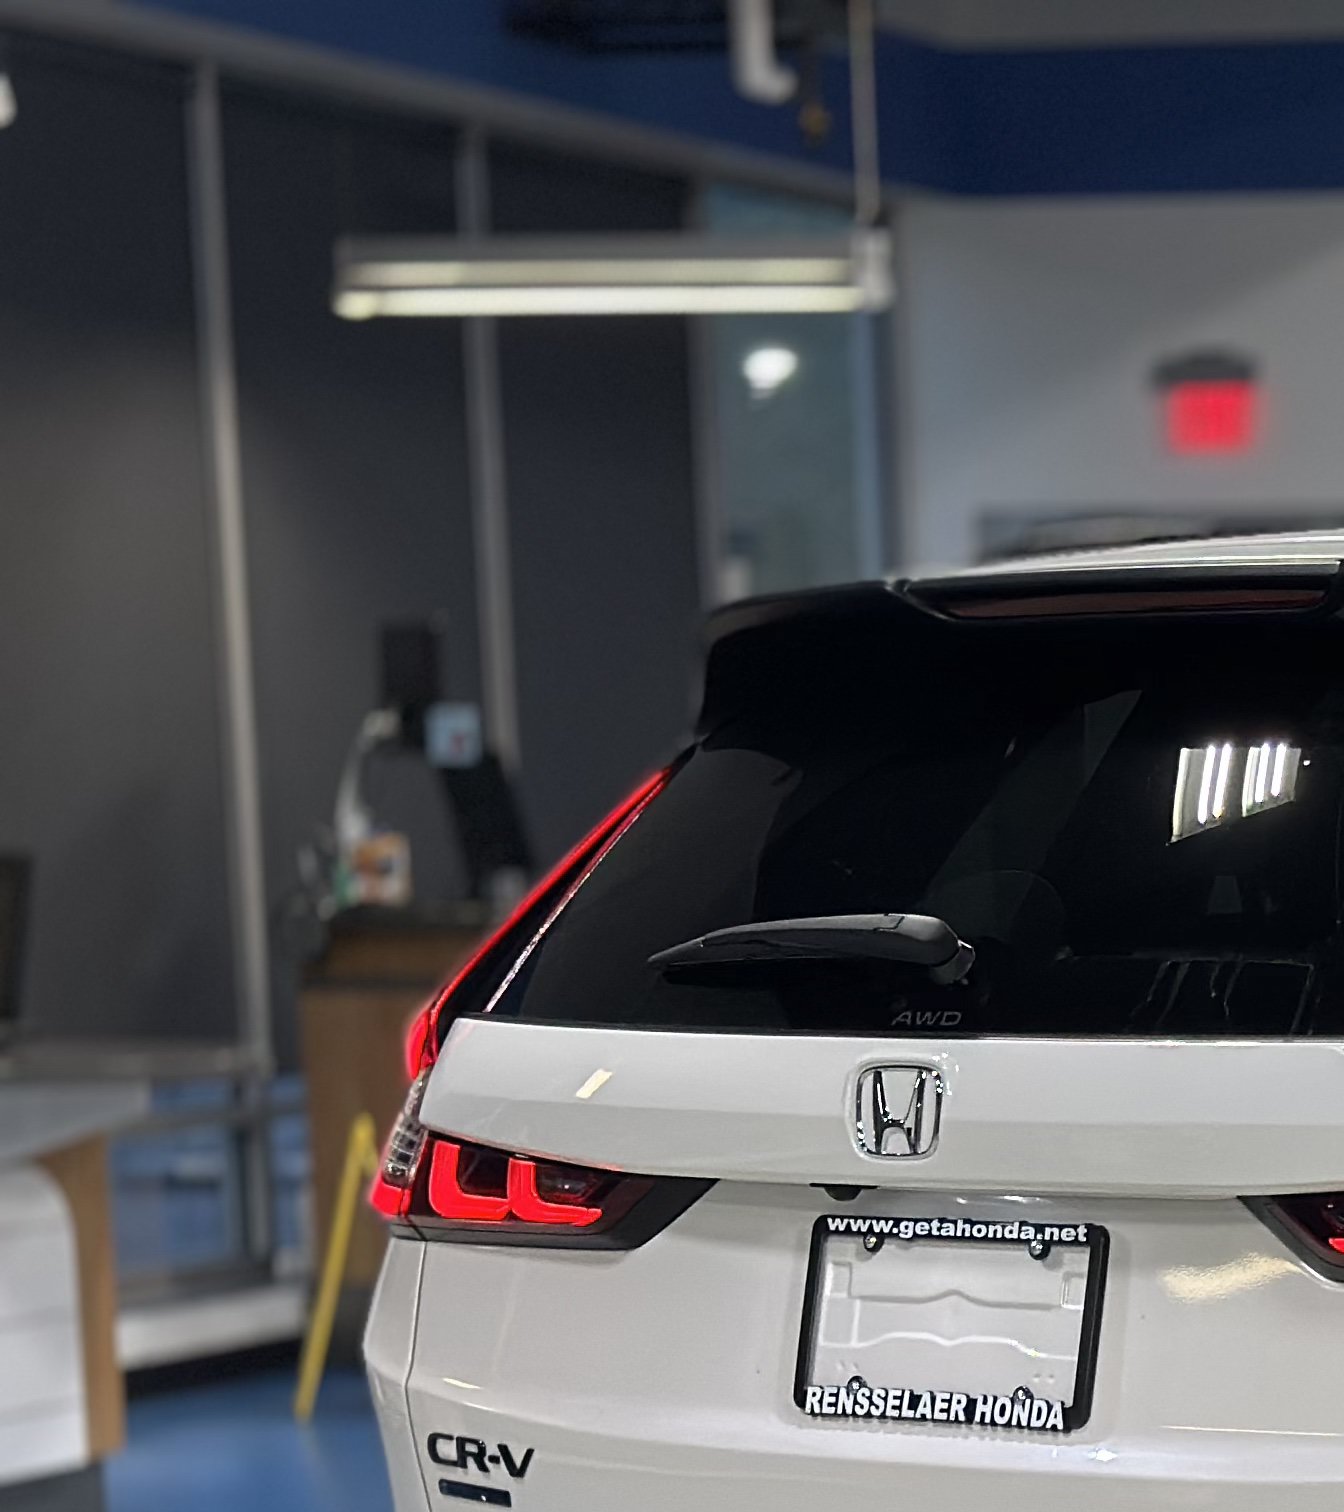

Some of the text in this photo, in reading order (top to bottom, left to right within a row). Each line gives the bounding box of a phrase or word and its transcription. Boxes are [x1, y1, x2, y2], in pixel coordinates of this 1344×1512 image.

[890, 1009, 962, 1027] AWD
[826, 1215, 1088, 1243] www.getahonda.net
[805, 1385, 1064, 1430] RENSSELAER HONDA
[427, 1432, 535, 1479] CR-V
